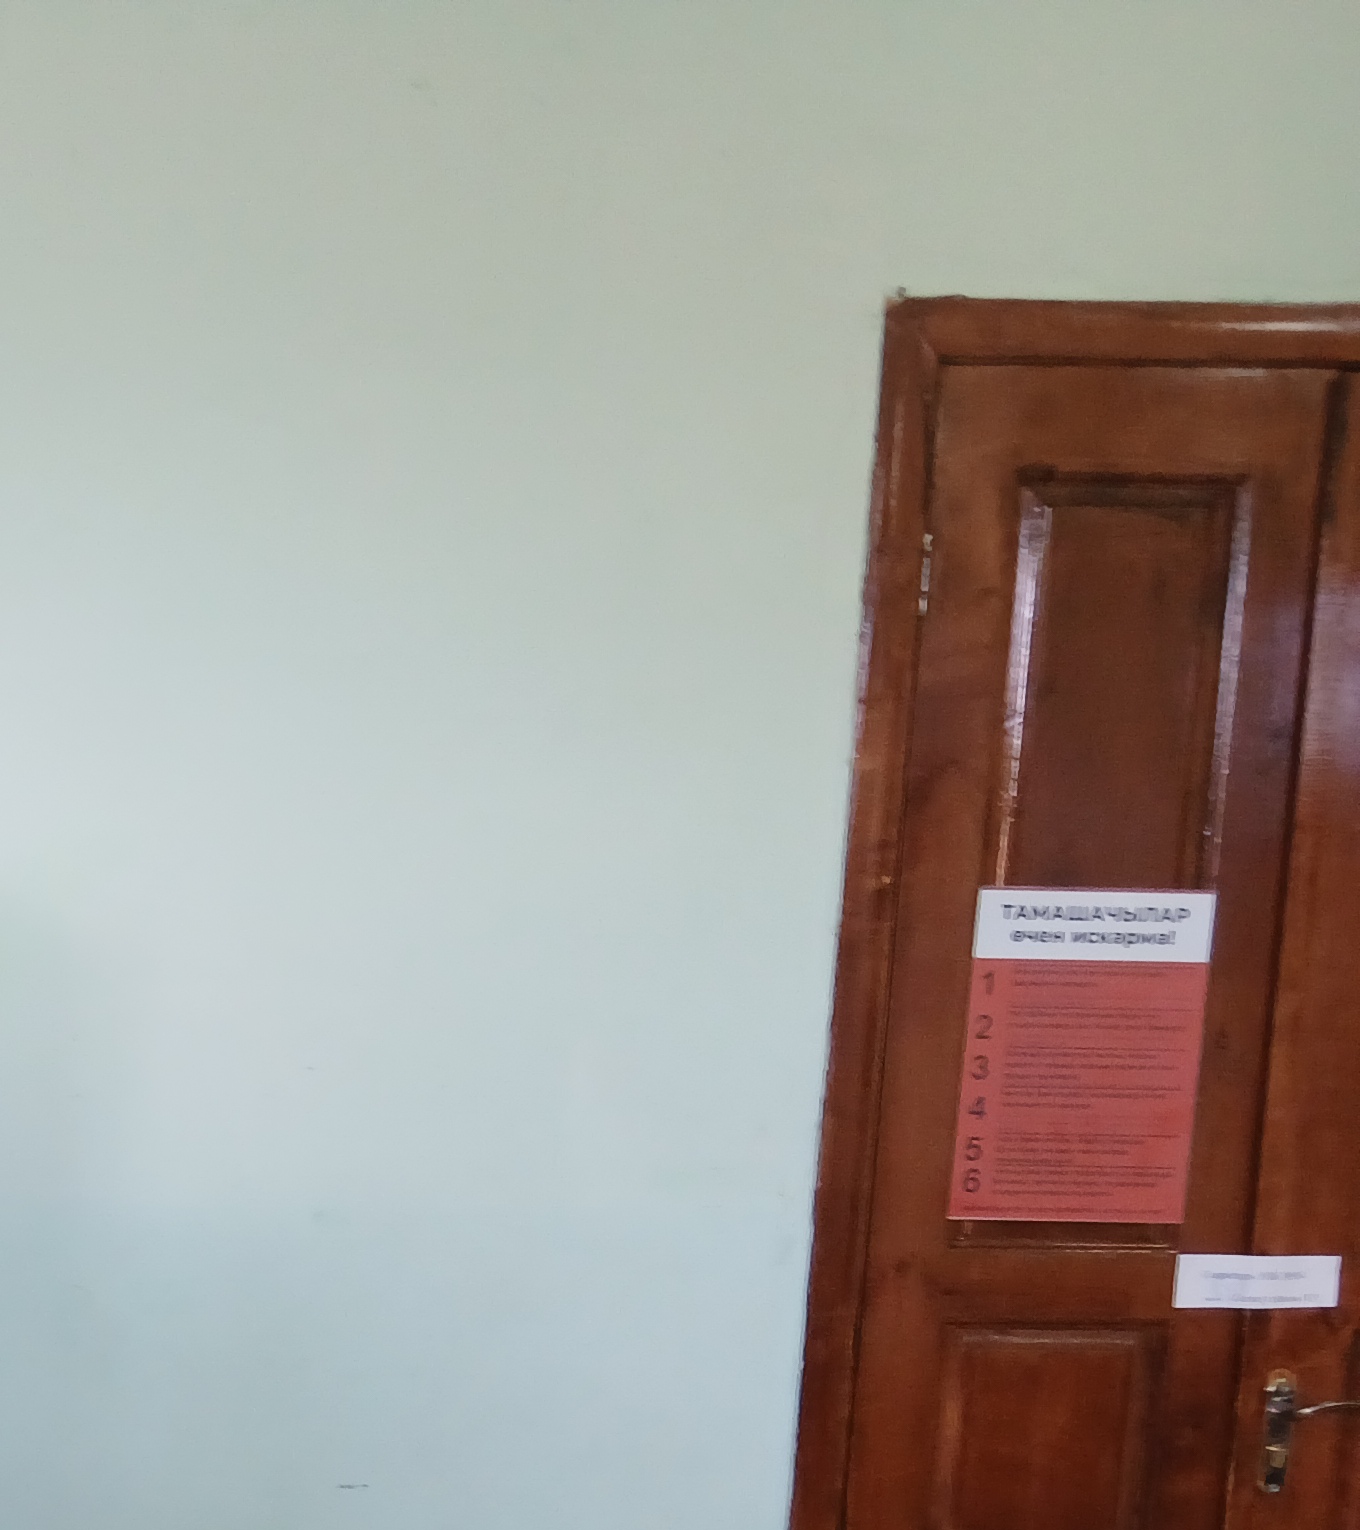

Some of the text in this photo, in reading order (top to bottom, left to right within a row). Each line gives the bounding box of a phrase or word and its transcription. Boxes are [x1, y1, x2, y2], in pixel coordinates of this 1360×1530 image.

[1000, 903, 1192, 923] ТАМАШАЧЫЛАР
[981, 970, 996, 996] 1
[975, 1014, 994, 1040] 2
[972, 1054, 990, 1081] 3
[968, 1096, 987, 1120] 4
[965, 1136, 985, 1162] 5
[961, 1167, 981, 1194] 6
